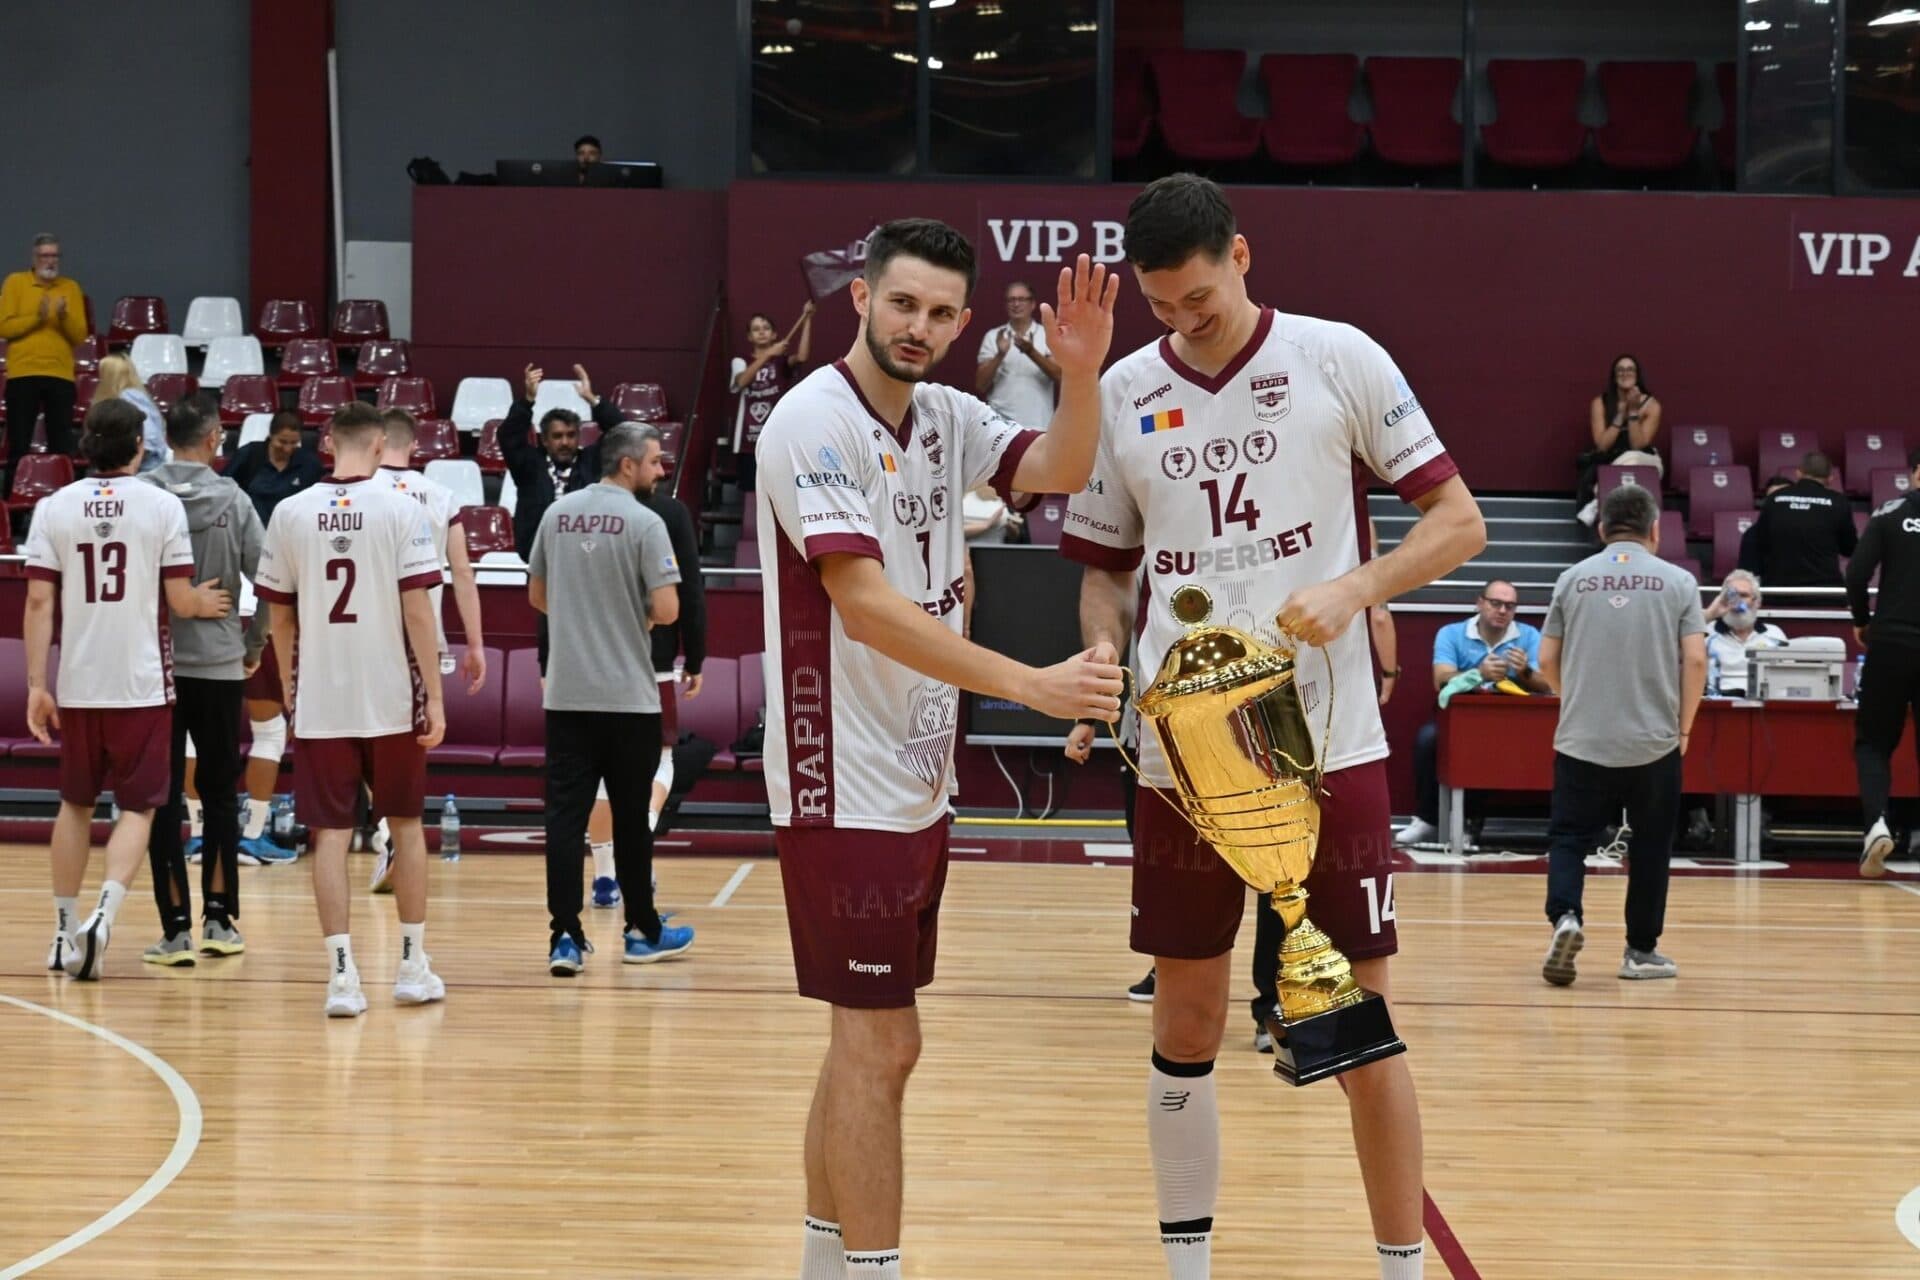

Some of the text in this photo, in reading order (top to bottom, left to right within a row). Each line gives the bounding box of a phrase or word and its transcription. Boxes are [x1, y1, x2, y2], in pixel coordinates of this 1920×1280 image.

[987, 219, 1126, 263] VIP B
[1798, 232, 1891, 276] VIP
[1255, 378, 1285, 389] RAPID
[1133, 383, 1173, 410] Kempa
[84, 500, 124, 518] KEEN
[1199, 472, 1260, 537] 14
[318, 512, 363, 532] RADU
[557, 514, 625, 535] RAPID
[1154, 521, 1313, 576] SUPERBET
[77, 541, 127, 603] 13
[1576, 575, 1664, 593] CS RAPID
[326, 558, 358, 624] 2
[792, 666, 828, 818] RAPID
[849, 959, 892, 977] Kempa
[1160, 1235, 1206, 1245] empa
[846, 1254, 899, 1266] Kempa
